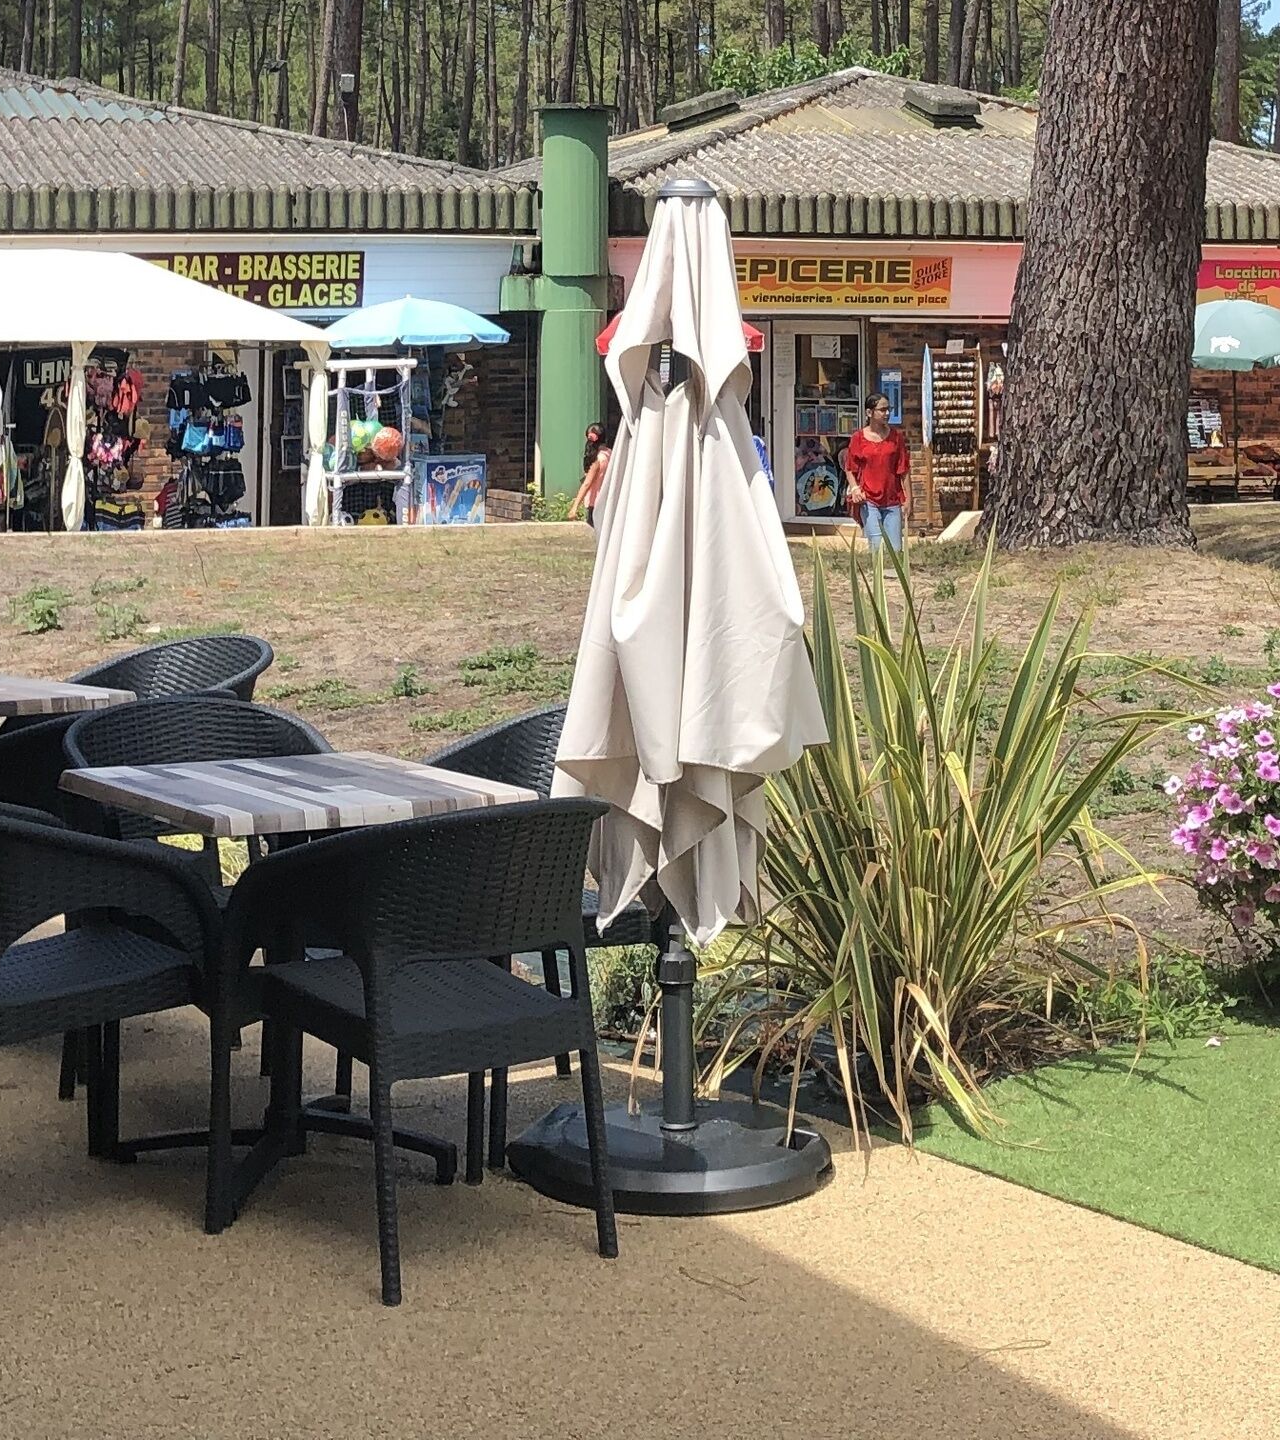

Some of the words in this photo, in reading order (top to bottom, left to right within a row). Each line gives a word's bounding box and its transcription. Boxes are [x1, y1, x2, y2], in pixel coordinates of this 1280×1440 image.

[173, 255, 219, 281] BAR
[238, 254, 361, 280] BRASSERIE
[1215, 265, 1280, 279] Location
[914, 270, 948, 289] STORE
[1238, 280, 1256, 293] de
[268, 283, 357, 307] GLACES
[752, 293, 833, 303] viennoiseries
[844, 293, 889, 303] cuisson
[893, 295, 914, 304] sur
[917, 294, 948, 306] place
